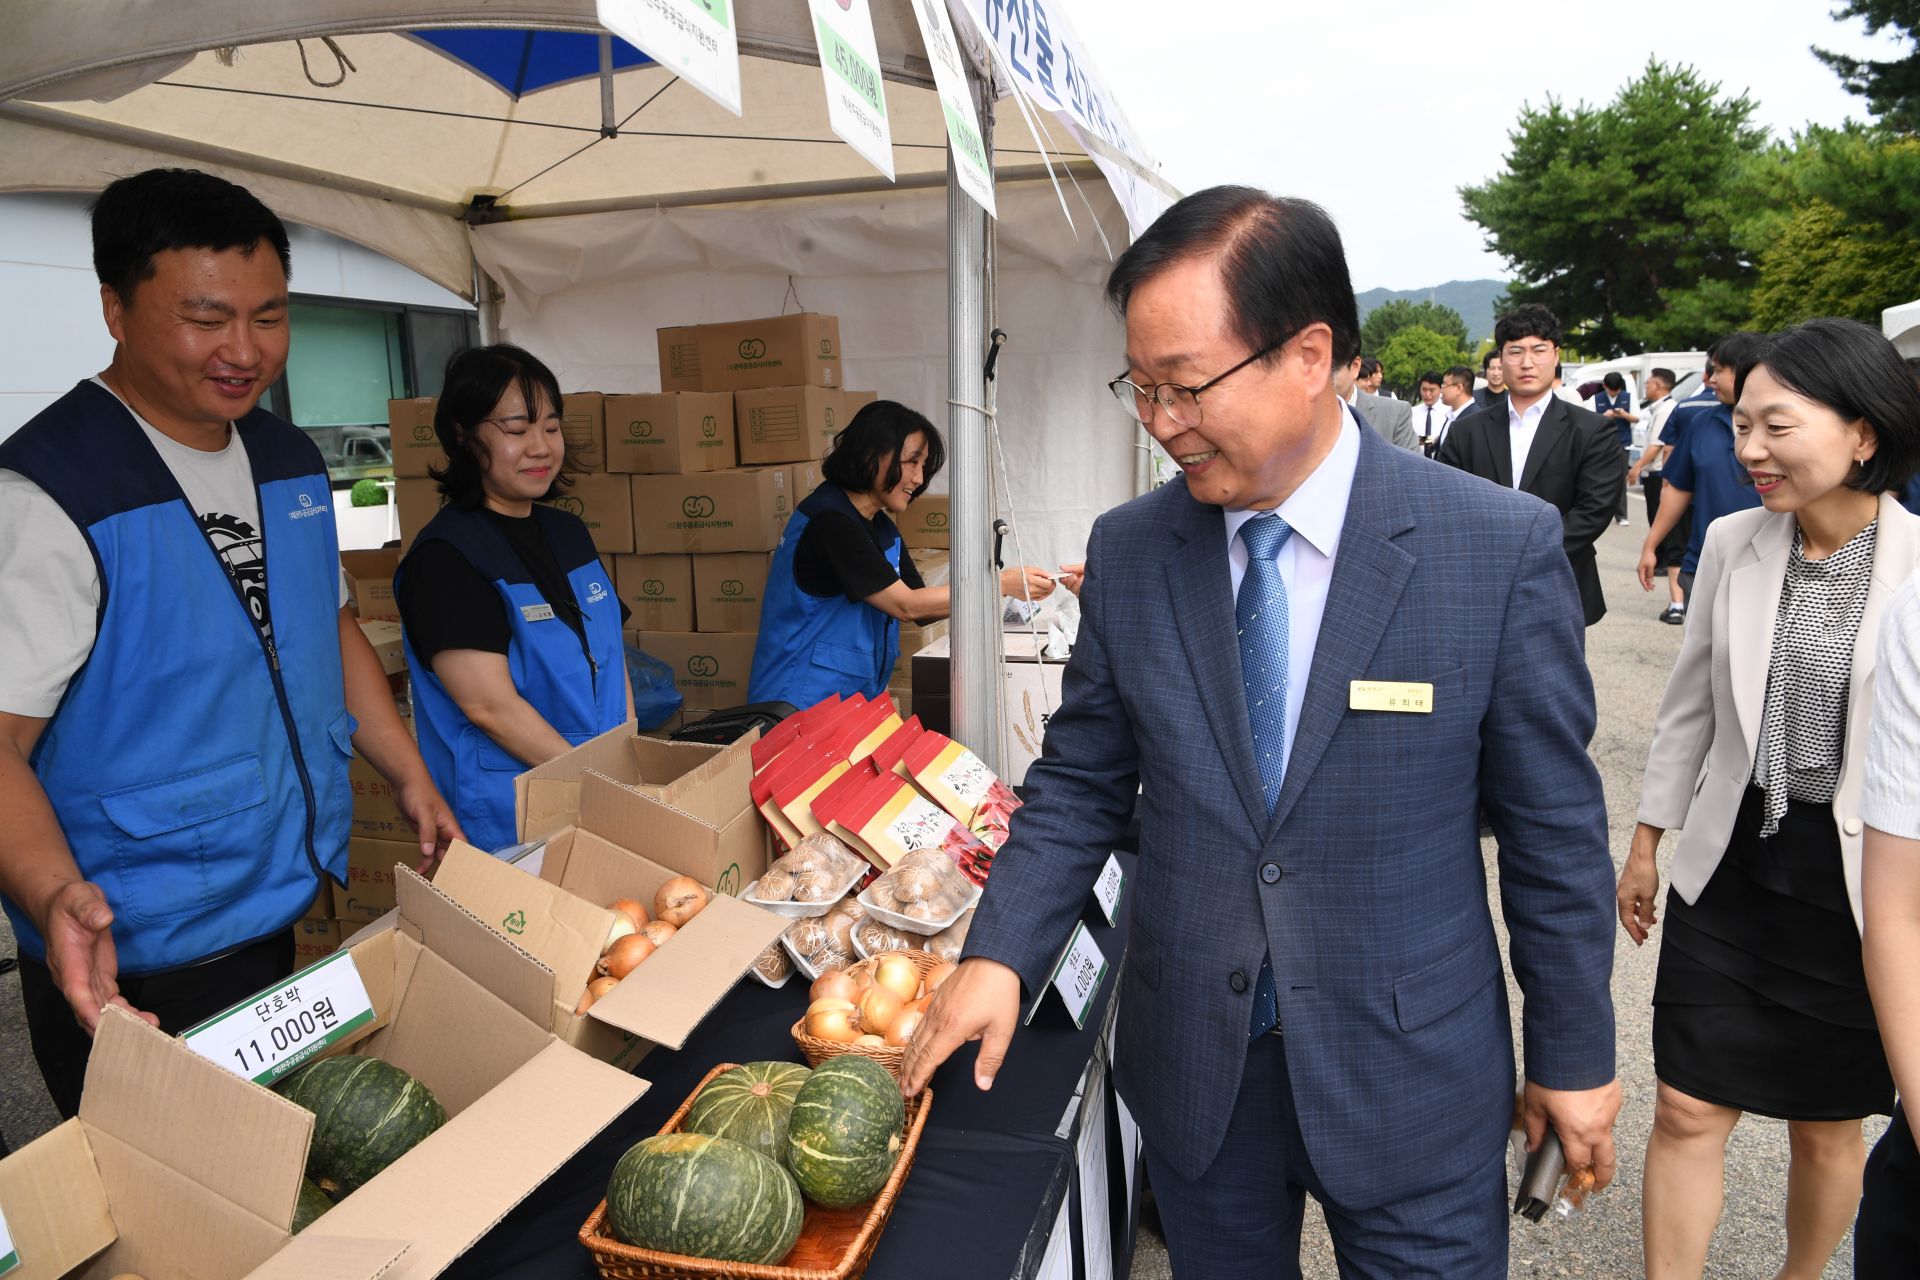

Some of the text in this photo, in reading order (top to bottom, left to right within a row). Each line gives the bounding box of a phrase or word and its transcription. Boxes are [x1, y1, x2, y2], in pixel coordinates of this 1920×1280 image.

[834, 38, 879, 110] 45,000원
[255, 985, 302, 1022] 단호박
[1074, 955, 1098, 999] 4,000원
[234, 996, 339, 1072] 11,000원
